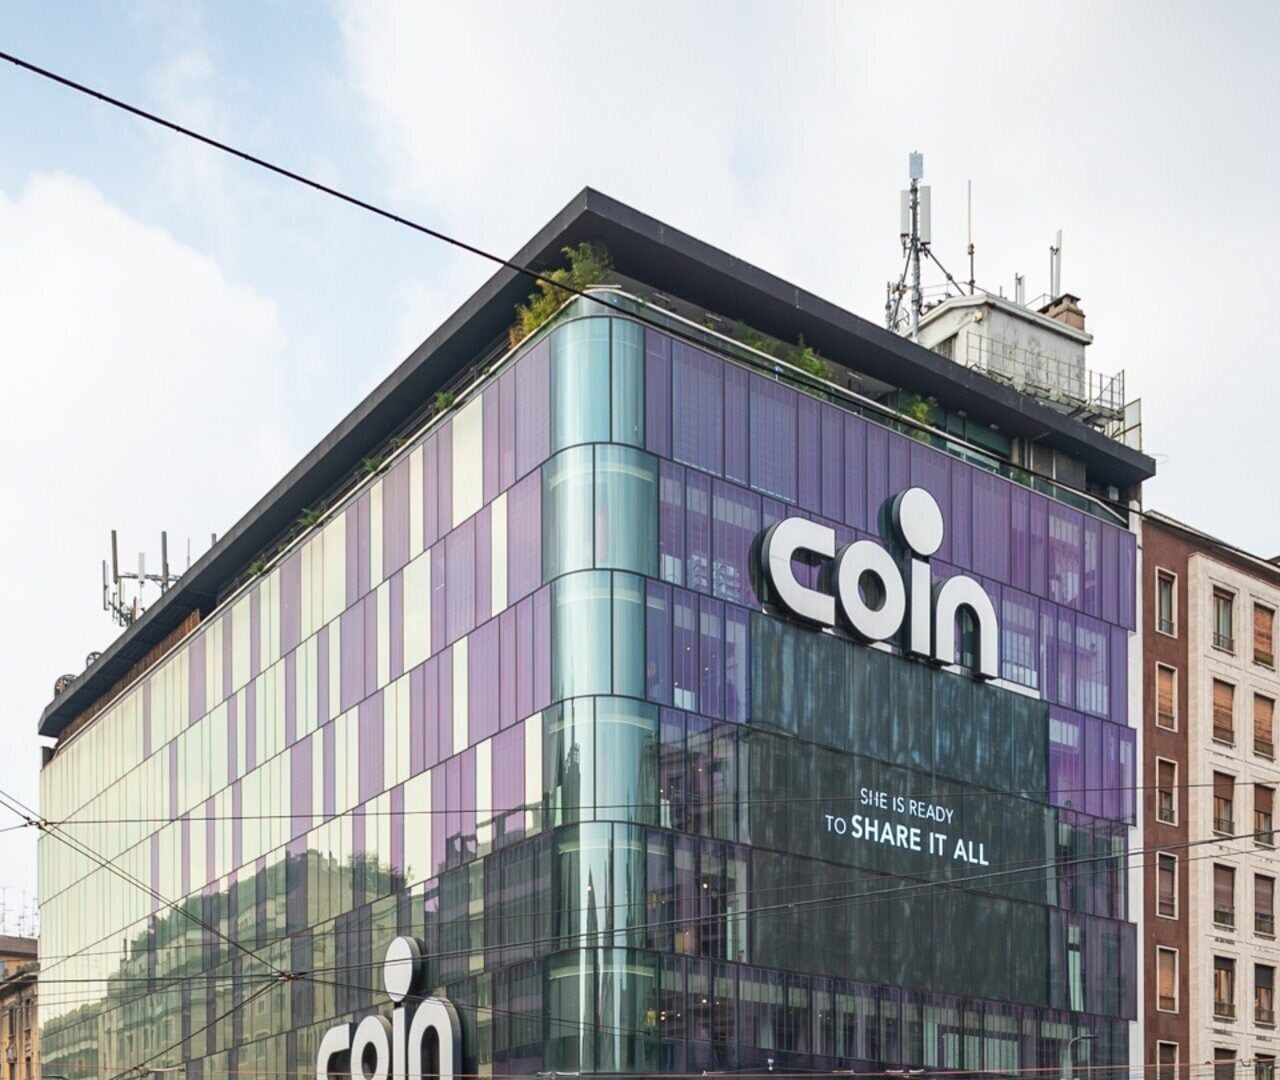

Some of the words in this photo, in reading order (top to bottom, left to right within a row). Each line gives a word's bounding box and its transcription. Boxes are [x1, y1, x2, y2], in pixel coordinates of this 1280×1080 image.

[766, 487, 999, 678] coin
[860, 787, 888, 809] SHE
[892, 796, 905, 813] IS
[909, 799, 954, 824] READY
[825, 814, 847, 835] TO
[851, 814, 922, 851] SHARE
[929, 832, 947, 856] IT
[953, 838, 989, 866] ALL
